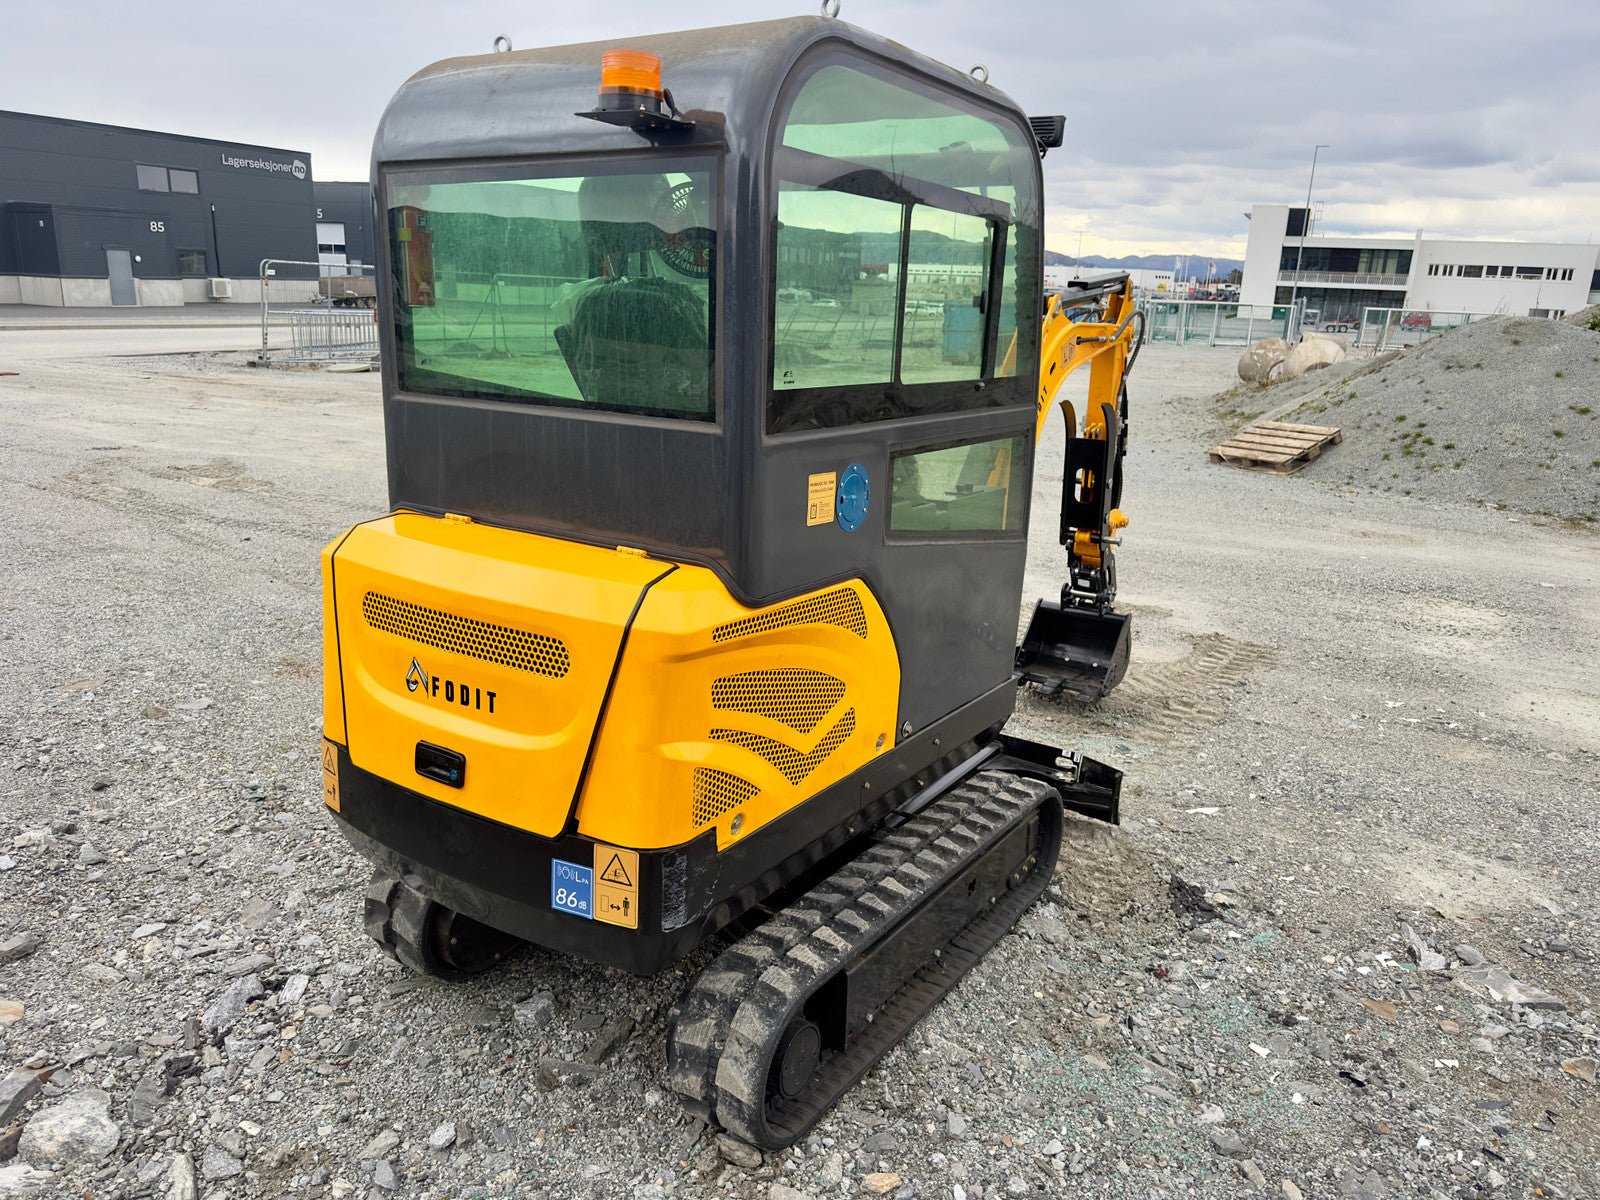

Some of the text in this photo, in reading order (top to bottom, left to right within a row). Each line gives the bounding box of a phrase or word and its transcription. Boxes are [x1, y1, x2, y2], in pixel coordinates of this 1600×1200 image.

[150, 221, 165, 232] 85
[432, 676, 496, 713] FODIT
[556, 888, 578, 907] 86
